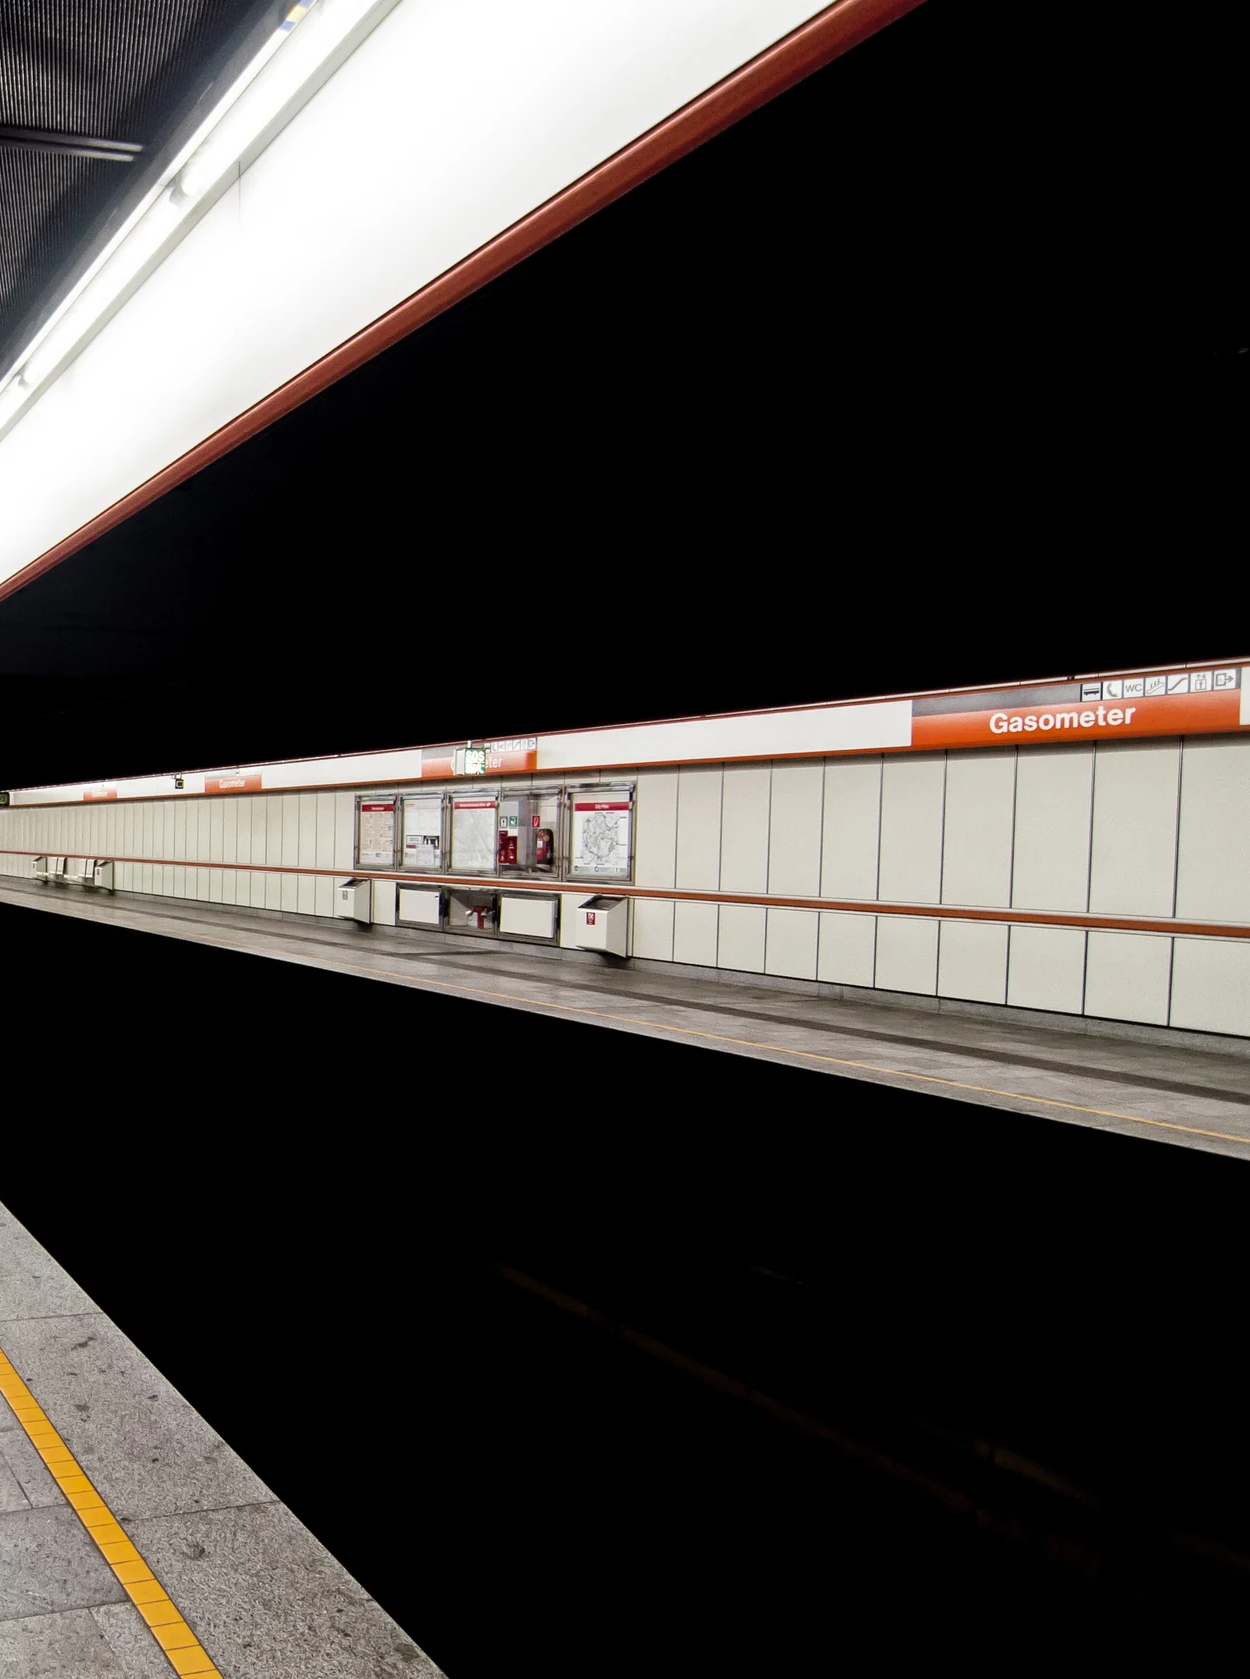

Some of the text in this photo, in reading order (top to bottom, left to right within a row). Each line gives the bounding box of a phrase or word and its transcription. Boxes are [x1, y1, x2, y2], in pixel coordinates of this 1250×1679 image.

[1124, 684, 1143, 694] WC
[989, 705, 1137, 735] Gasometer
[465, 751, 485, 763] SOS
